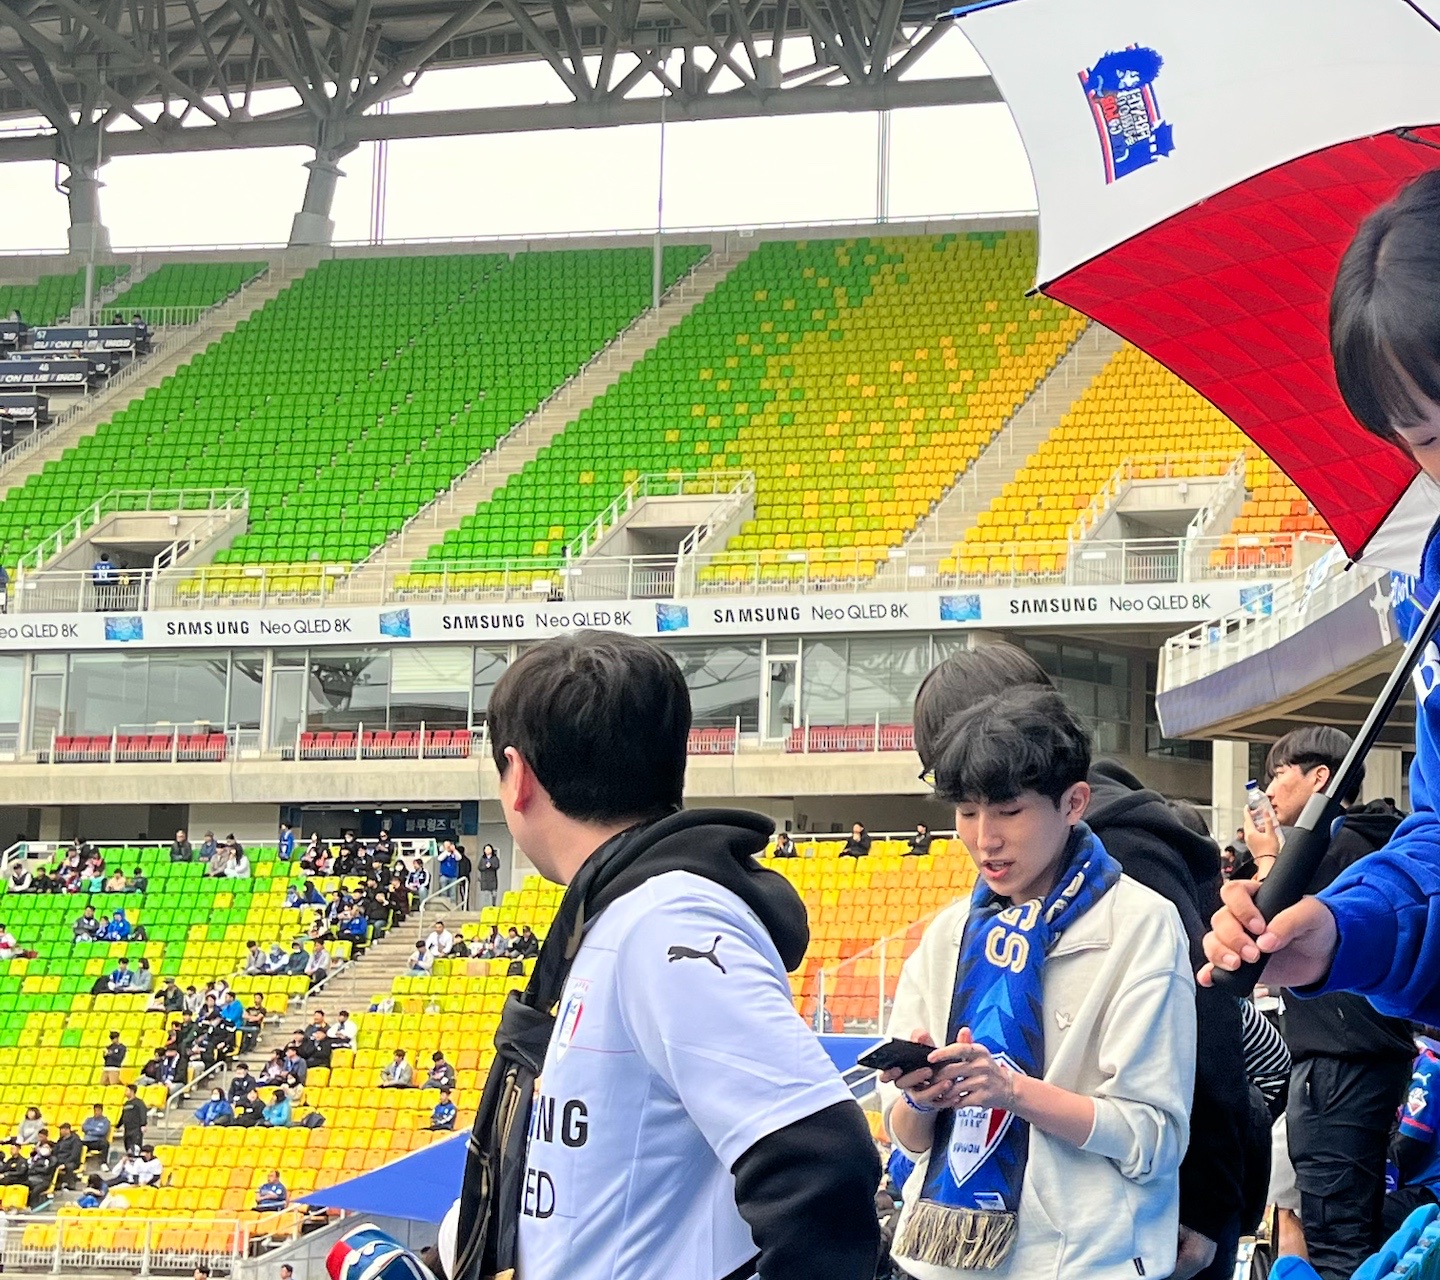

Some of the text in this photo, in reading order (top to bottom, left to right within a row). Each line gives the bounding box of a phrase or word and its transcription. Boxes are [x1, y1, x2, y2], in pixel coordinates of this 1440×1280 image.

[714, 603, 909, 623] SAMSUNG Neo QLED 8K
[1010, 594, 1211, 614] SAMSUNG Neo QLED 8K
[167, 618, 352, 636] SAMSUNG Neo QLED 8K
[443, 611, 632, 630] SAMSUNG Neo QLED 8K
[0, 624, 79, 639] eo QLED 8K
[536, 1095, 589, 1148] NG
[523, 1168, 556, 1219] ED
